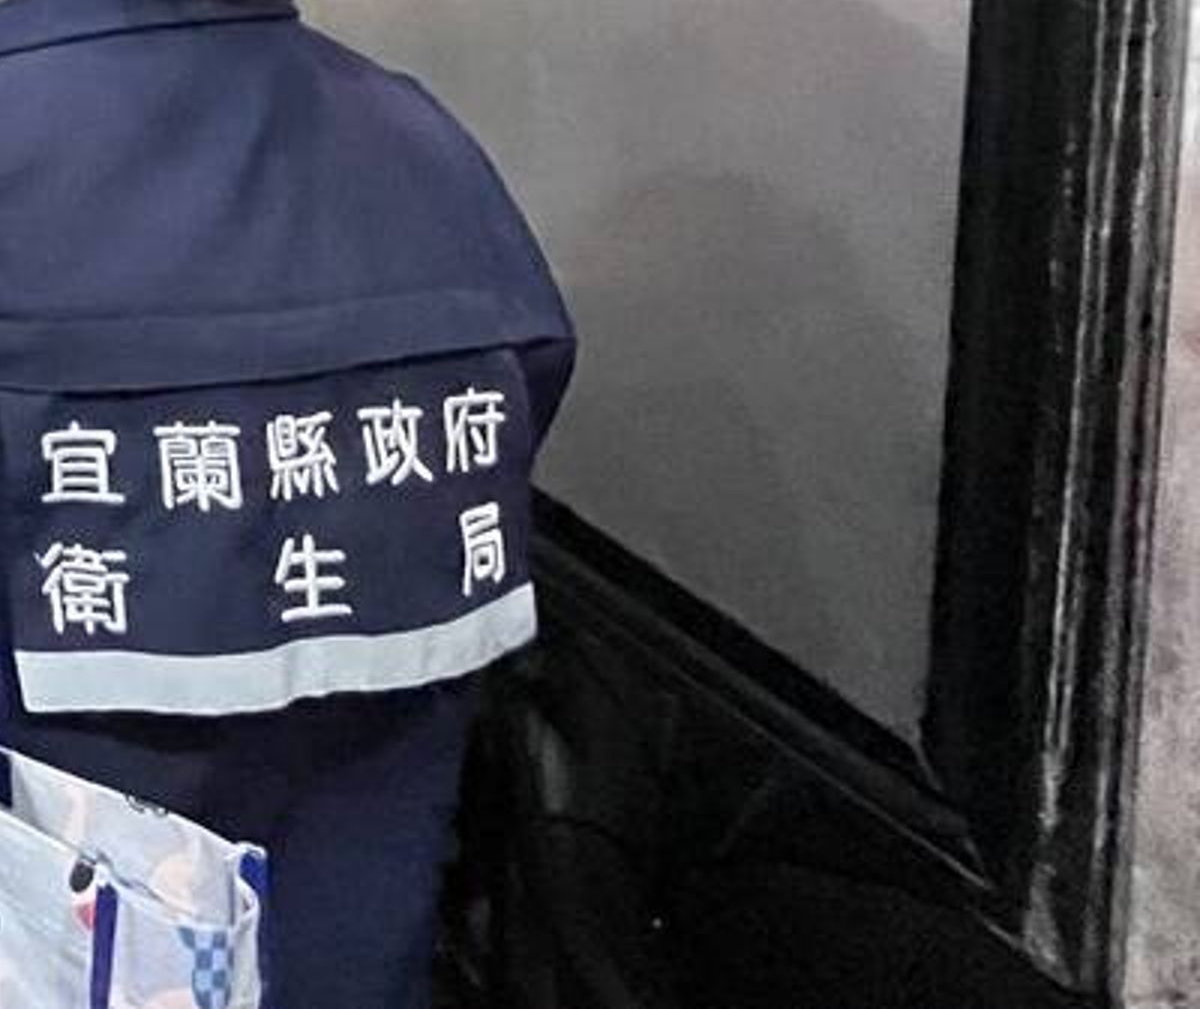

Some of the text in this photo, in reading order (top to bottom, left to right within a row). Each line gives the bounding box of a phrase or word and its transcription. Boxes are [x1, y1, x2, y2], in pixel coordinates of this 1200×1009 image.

[41, 387, 506, 512] 宜蘭縣政府
[35, 502, 505, 635] 衛生局
